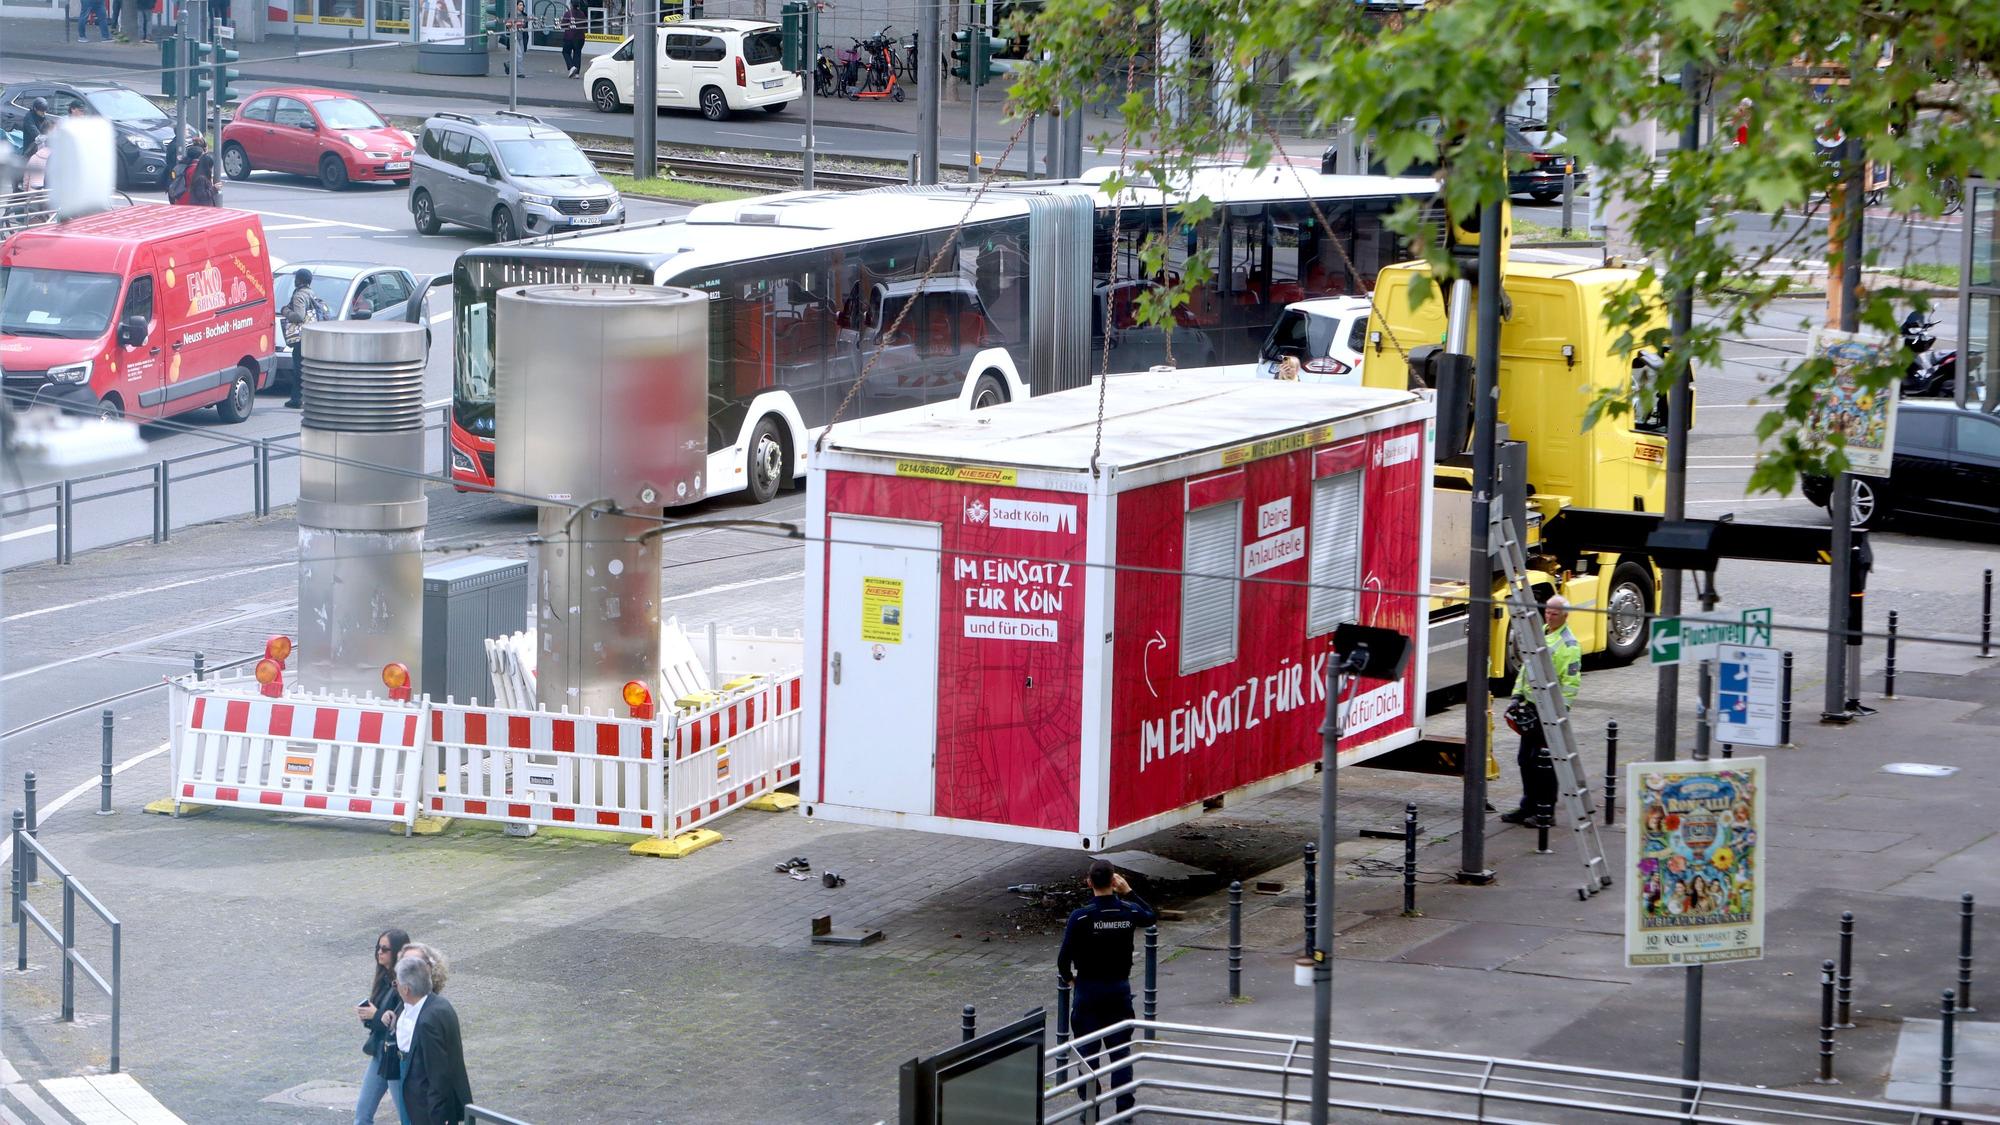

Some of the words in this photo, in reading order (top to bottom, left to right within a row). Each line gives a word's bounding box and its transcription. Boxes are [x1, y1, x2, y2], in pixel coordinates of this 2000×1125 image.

[706, 279, 720, 287] MAN
[183, 331, 202, 345] Neuss
[205, 320, 230, 339] Bocholt
[232, 317, 253, 331] Hamm
[1251, 434, 1305, 457] MIETCONTAINER
[898, 463, 955, 476] 0214/8680220
[993, 508, 1022, 521] Stadt
[1024, 510, 1049, 523] Köln
[1263, 507, 1289, 529] Deine
[1248, 534, 1301, 568] Anlaufstelle
[954, 557, 978, 580] IM
[965, 583, 1008, 610] FÜR
[970, 621, 995, 634] und
[998, 621, 1018, 635] für
[1021, 623, 1054, 637] Dich.
[1682, 623, 1743, 647] Fluchtweg
[1140, 718, 1165, 773] IM
[1264, 658, 1306, 720] FÜR
[1358, 701, 1376, 723] für
[1376, 687, 1401, 716] Dich.
[1093, 920, 1131, 929] KÜMMERER
[1664, 933, 1688, 946] KÖLN
